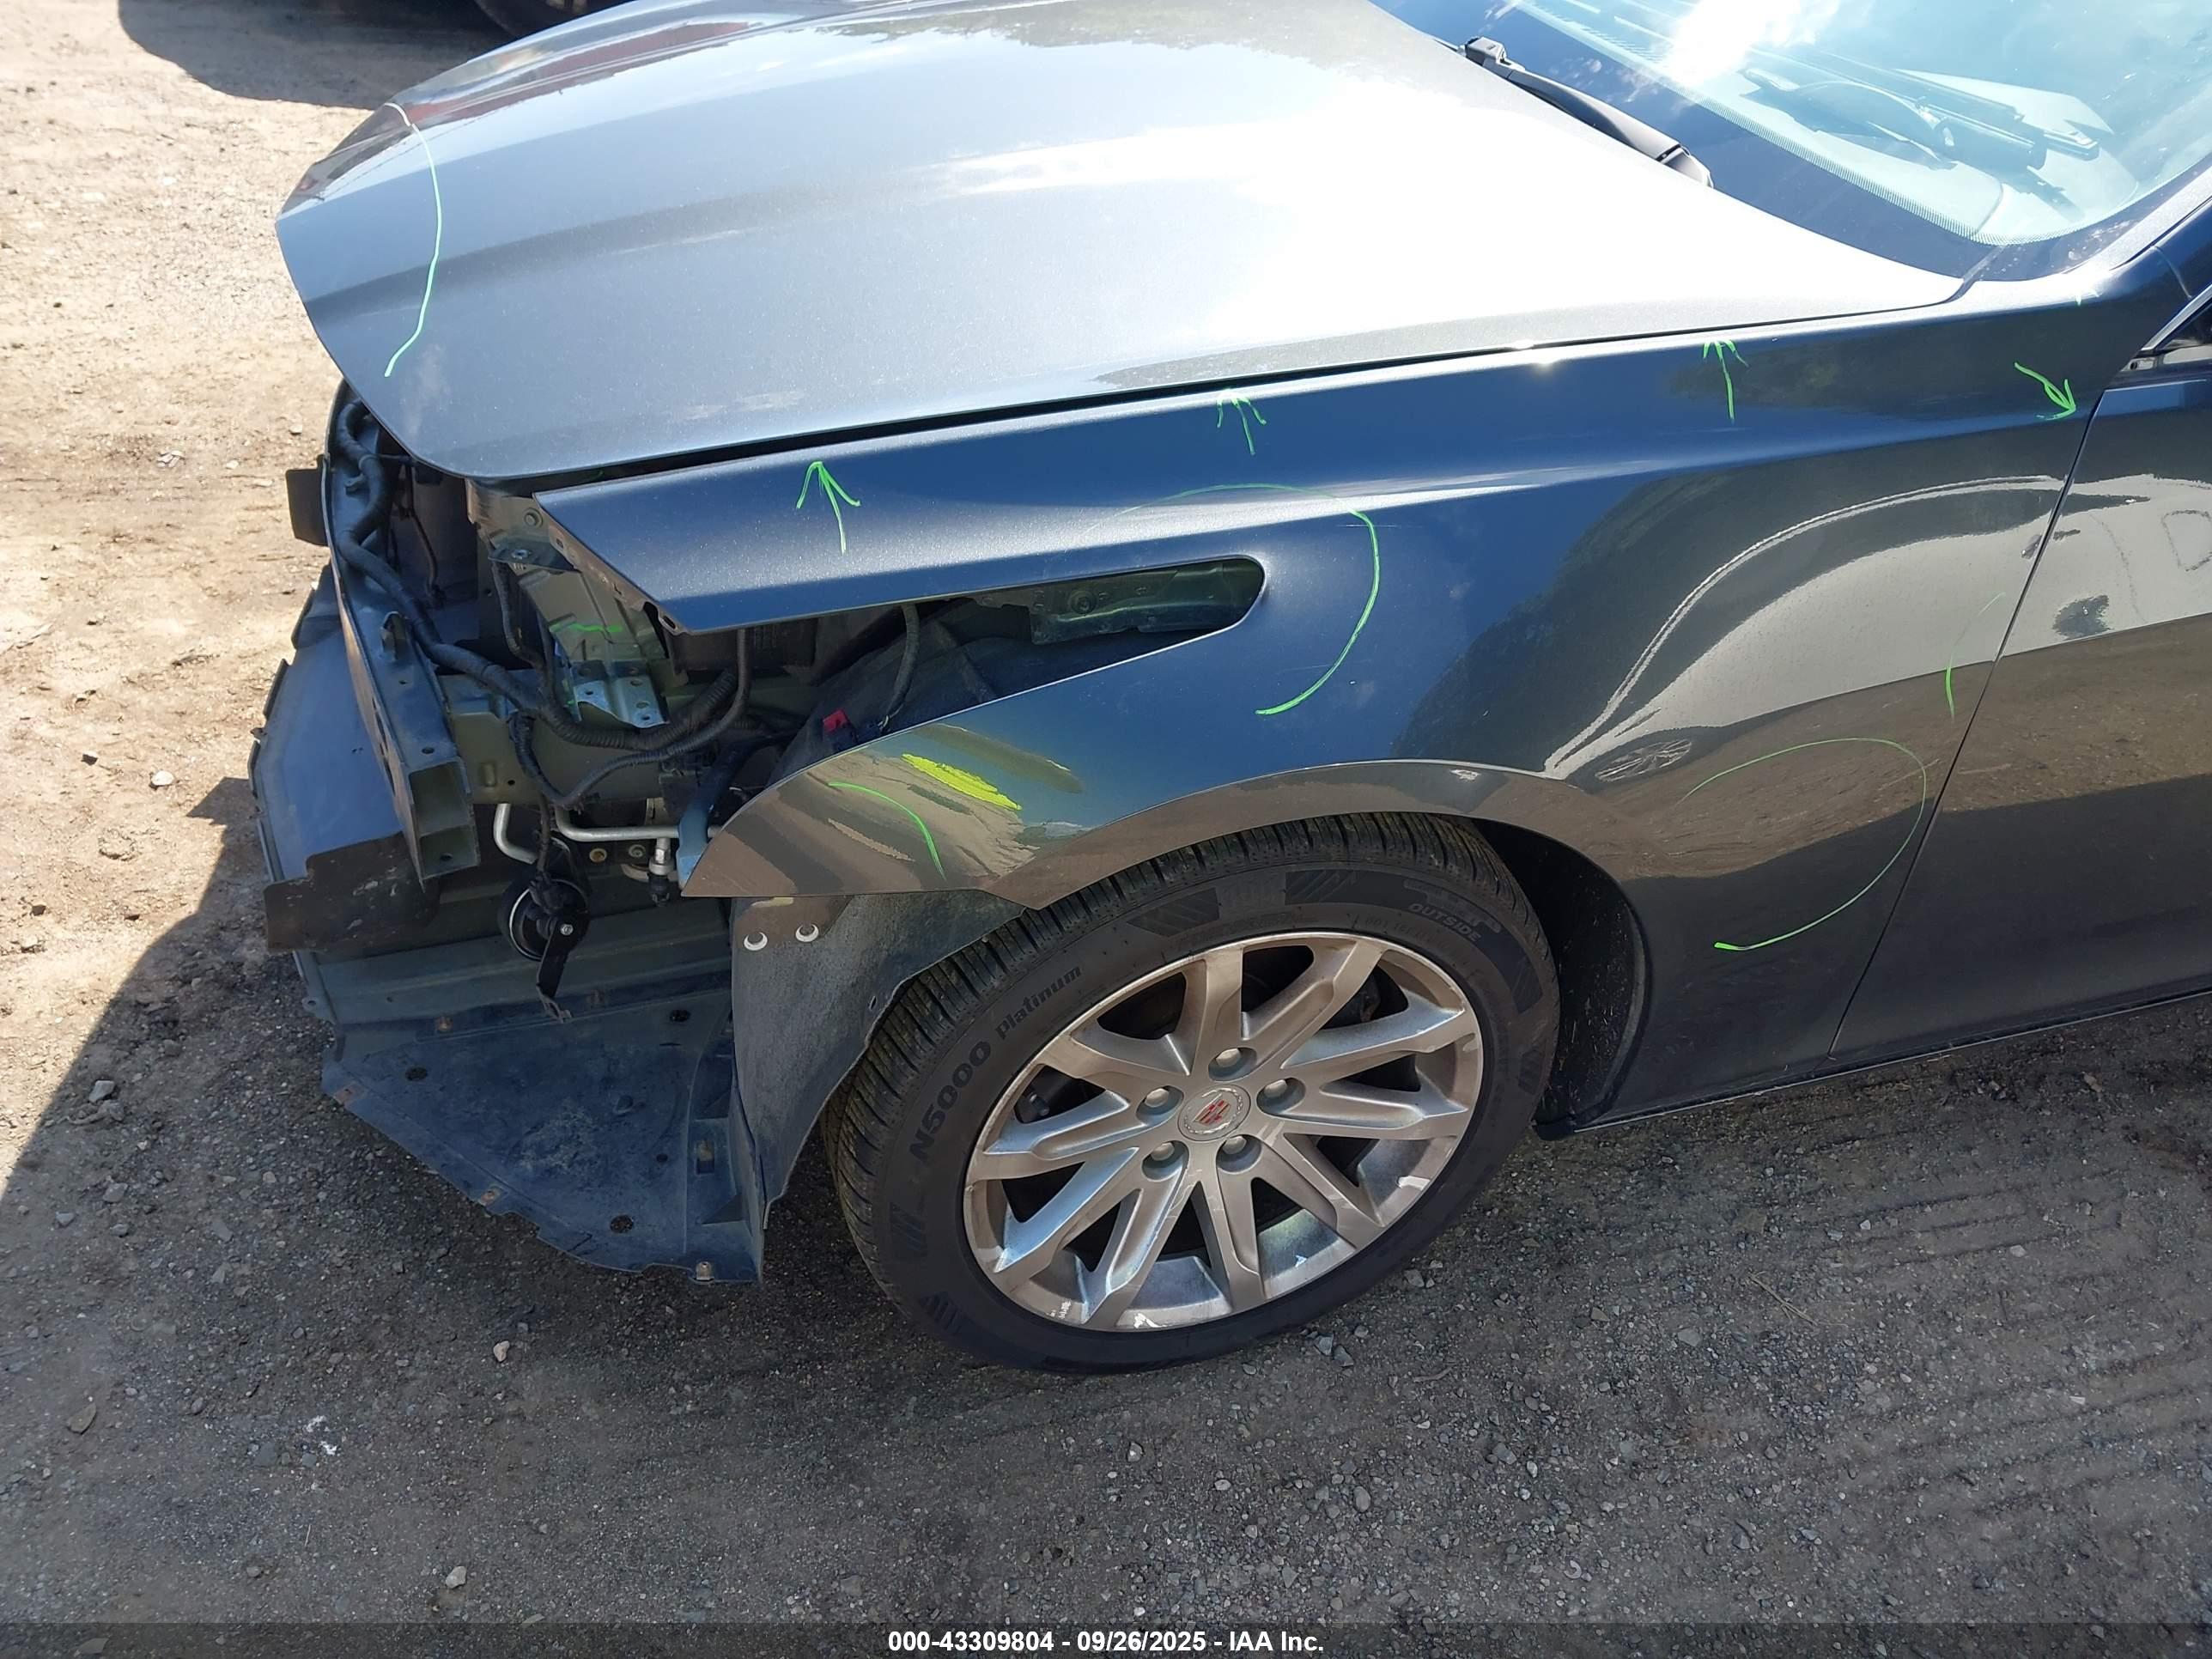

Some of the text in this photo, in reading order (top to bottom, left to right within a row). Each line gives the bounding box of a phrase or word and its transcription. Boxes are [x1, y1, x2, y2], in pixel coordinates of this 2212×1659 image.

[1408, 902, 1483, 943] OUTSIDE
[909, 966, 1082, 1162] N5000 platinum
